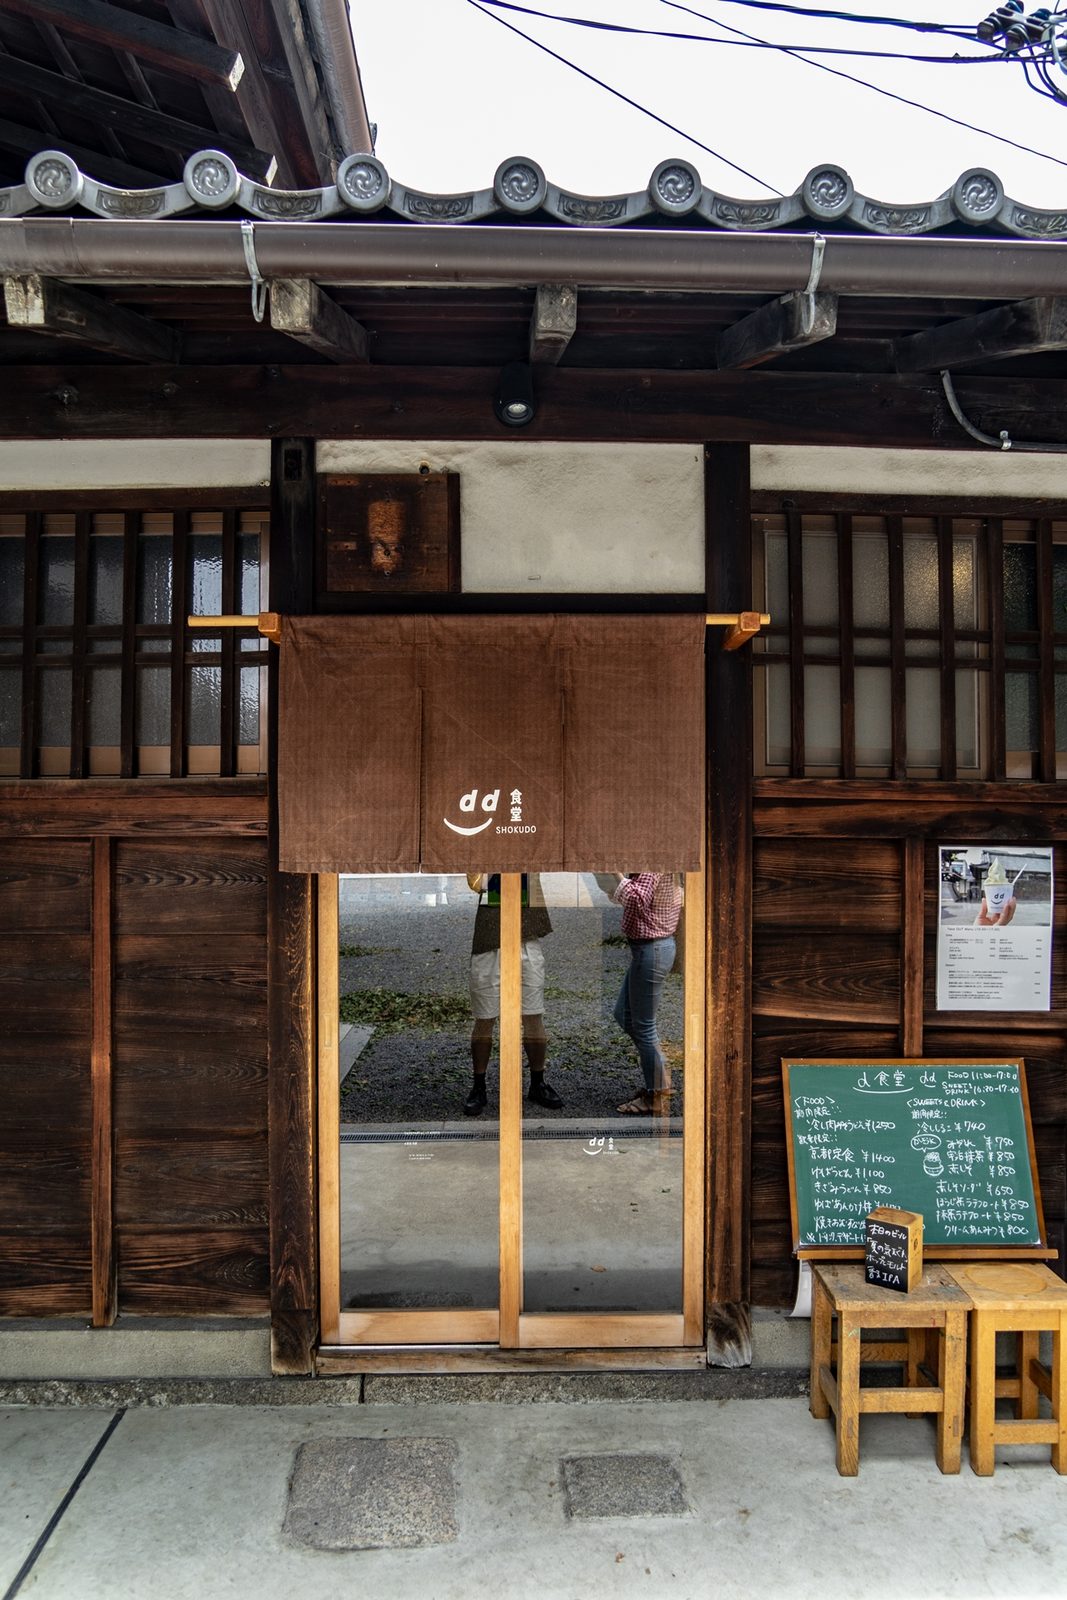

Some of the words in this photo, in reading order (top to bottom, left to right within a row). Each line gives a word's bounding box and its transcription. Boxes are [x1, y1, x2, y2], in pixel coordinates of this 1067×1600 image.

[510, 788, 522, 822] 食堂
[495, 825, 537, 834] SHOKUDO
[808, 1145, 856, 1162] 京都定食
